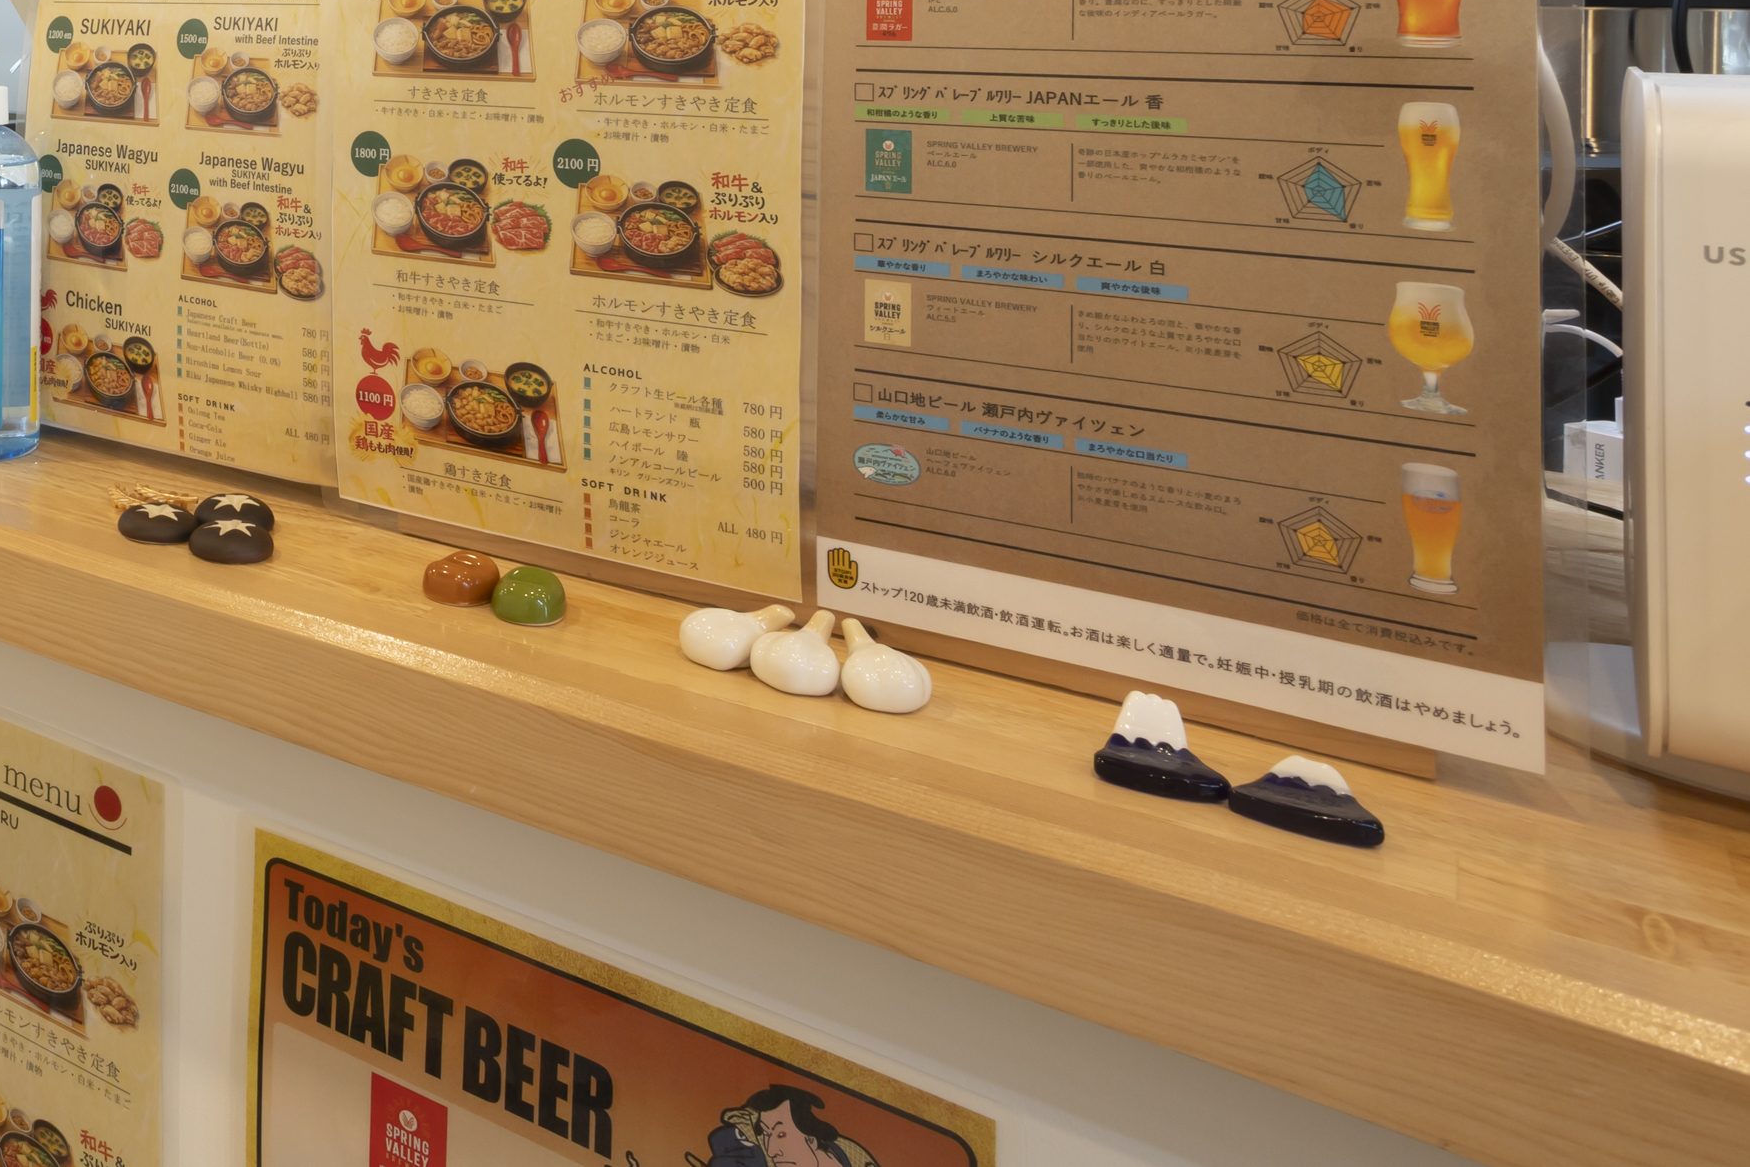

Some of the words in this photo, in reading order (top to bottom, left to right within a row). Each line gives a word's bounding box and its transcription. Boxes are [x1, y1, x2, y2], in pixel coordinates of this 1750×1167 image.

[80, 18, 151, 36] SUKIYAKI
[213, 17, 278, 31] SUKIYAKI
[235, 34, 253, 44] with
[256, 35, 276, 44] Beef
[278, 36, 319, 46] Intestine
[407, 86, 488, 103] すきやき定食
[594, 92, 758, 114] ホルモンすきやき定食
[989, 113, 1035, 124] 上質な苦味
[56, 139, 112, 159] Japanese
[116, 144, 158, 166] Wagyu
[926, 140, 958, 150] SPRING
[960, 143, 993, 152] VALLEY
[995, 144, 1038, 154] BREWERY
[85, 159, 130, 174] SUKIYAKI
[199, 152, 257, 173] Japanese
[261, 157, 304, 177] Wagyu
[502, 158, 529, 172] 和牛
[231, 170, 270, 181] SUKIYAKI
[209, 178, 228, 188] with
[230, 179, 250, 190] Beef
[253, 181, 292, 194] Intestine
[711, 192, 765, 208] ぷりぷり
[276, 212, 313, 227] ぷりぷり
[709, 207, 778, 225] ホルモン入り
[274, 226, 322, 240] ホルモン入り
[976, 269, 1048, 283] まろやかな味わい
[1150, 260, 1166, 276] 白
[396, 270, 500, 295] 和牛すきやき定食
[65, 291, 122, 316] Chicken
[179, 295, 218, 308] ALCOHOL
[926, 295, 957, 304] SPRING
[960, 298, 993, 308] VALLEY
[995, 301, 1038, 313] BREWERY
[186, 309, 216, 321] Japanese
[219, 315, 238, 325] Craft
[242, 319, 257, 328] Beer
[592, 294, 757, 329] ホルモンすきやき定食
[105, 318, 151, 336] SUKIYAKI
[186, 357, 219, 370] Hiroshima
[223, 364, 242, 374] Lemon
[246, 368, 261, 378] Sour
[584, 364, 642, 380] ALCOHOL
[205, 376, 235, 388] Japanese
[238, 381, 262, 393] Whisky
[266, 385, 298, 400] Highball
[609, 382, 723, 409] クラフト生ビール各種
[178, 394, 200, 404] SOFT
[206, 400, 235, 412] DRINK
[878, 388, 976, 413] 山口地ビール
[188, 407, 210, 419] Oolong
[214, 412, 225, 421] Tea
[188, 420, 222, 434] Coca-Cola
[364, 421, 395, 441] 国産
[609, 422, 699, 443] 広島レモンサワー
[189, 433, 211, 445] Ginger
[215, 437, 226, 448] Ale
[190, 446, 212, 458] Orange
[216, 452, 235, 462] Juice
[444, 462, 512, 489] 鶏すき定食
[610, 455, 721, 482] ノンアルコールビール
[582, 479, 613, 491] SOFT
[624, 487, 667, 502] DRINK
[610, 515, 640, 528] コーラ
[610, 529, 687, 553] ジンジャエール
[610, 544, 699, 570] オレンジジュース
[3, 764, 82, 816] menu
[85, 921, 124, 948] ぷりぷり
[283, 879, 425, 974] Today's
[76, 931, 137, 971] ホルモン入り
[282, 932, 453, 1080] CRAFT
[462, 1006, 613, 1160] BEER
[386, 1123, 429, 1155] SPRING
